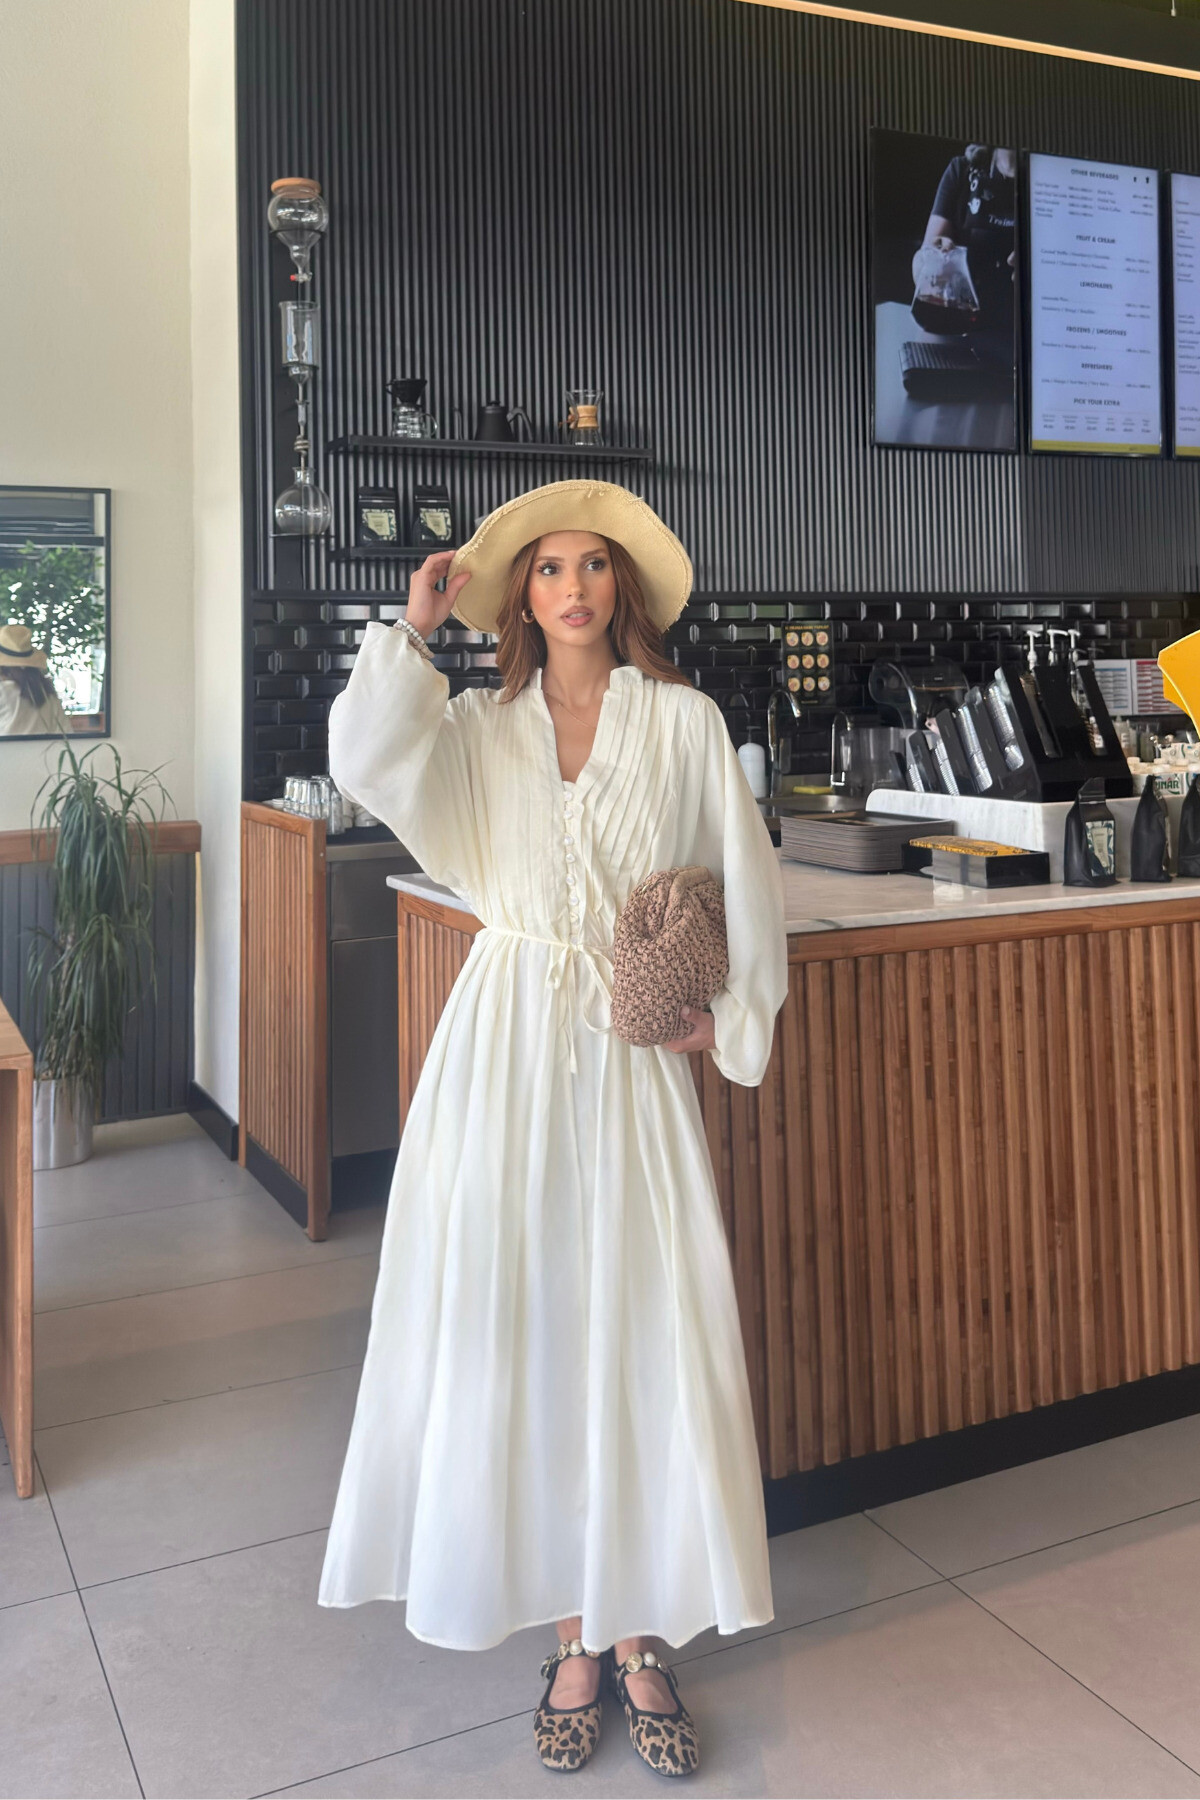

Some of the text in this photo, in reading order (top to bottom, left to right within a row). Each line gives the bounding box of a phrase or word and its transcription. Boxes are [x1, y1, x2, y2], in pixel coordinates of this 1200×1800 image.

[1070, 168, 1119, 181] OTHER BEVERAGES
[1076, 234, 1092, 242] FRUIT
[1097, 236, 1116, 244] CREAM
[1080, 281, 1113, 290] LEMONADES
[1081, 363, 1113, 371] REFRESHERS
[1073, 397, 1121, 407] PICK YOUR EXTRA
